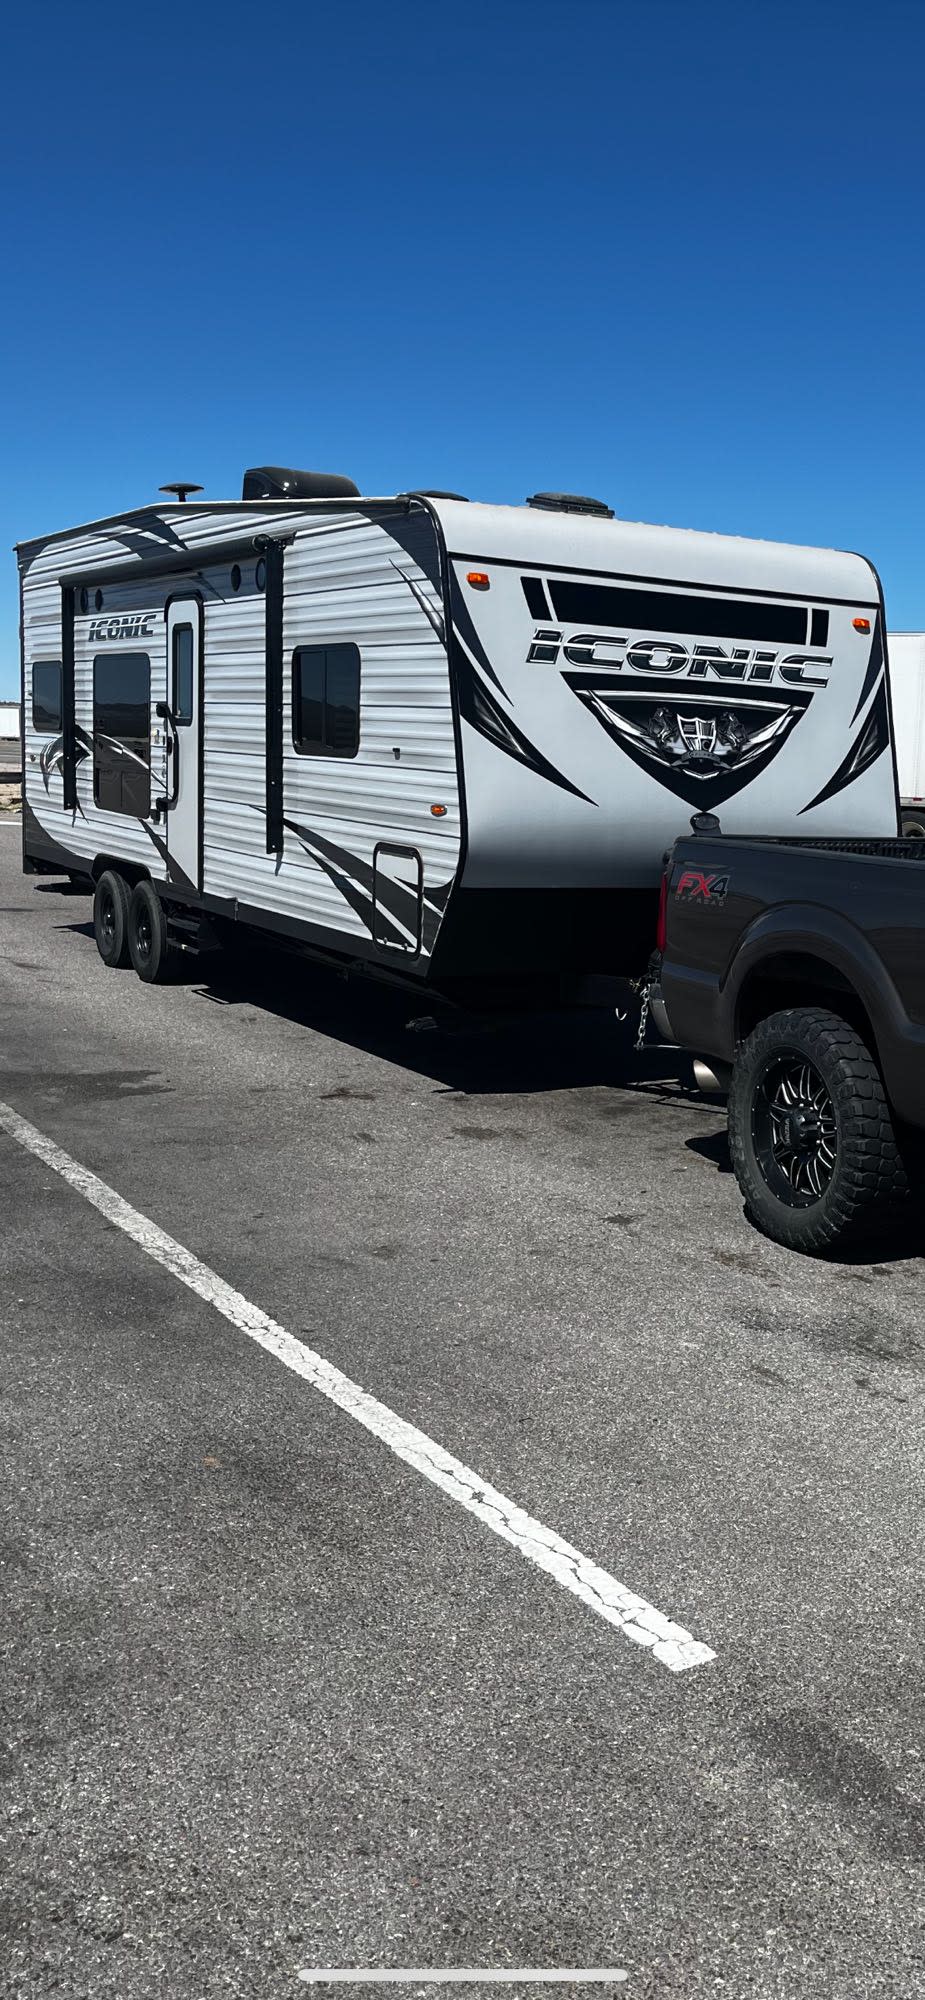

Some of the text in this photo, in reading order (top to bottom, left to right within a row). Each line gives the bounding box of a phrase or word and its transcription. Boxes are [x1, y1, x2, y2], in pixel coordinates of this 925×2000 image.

[88, 614, 157, 642] ICONIC
[526, 627, 834, 689] ICONIC
[676, 871, 730, 899] FX4
[696, 897, 724, 906] ROAD
